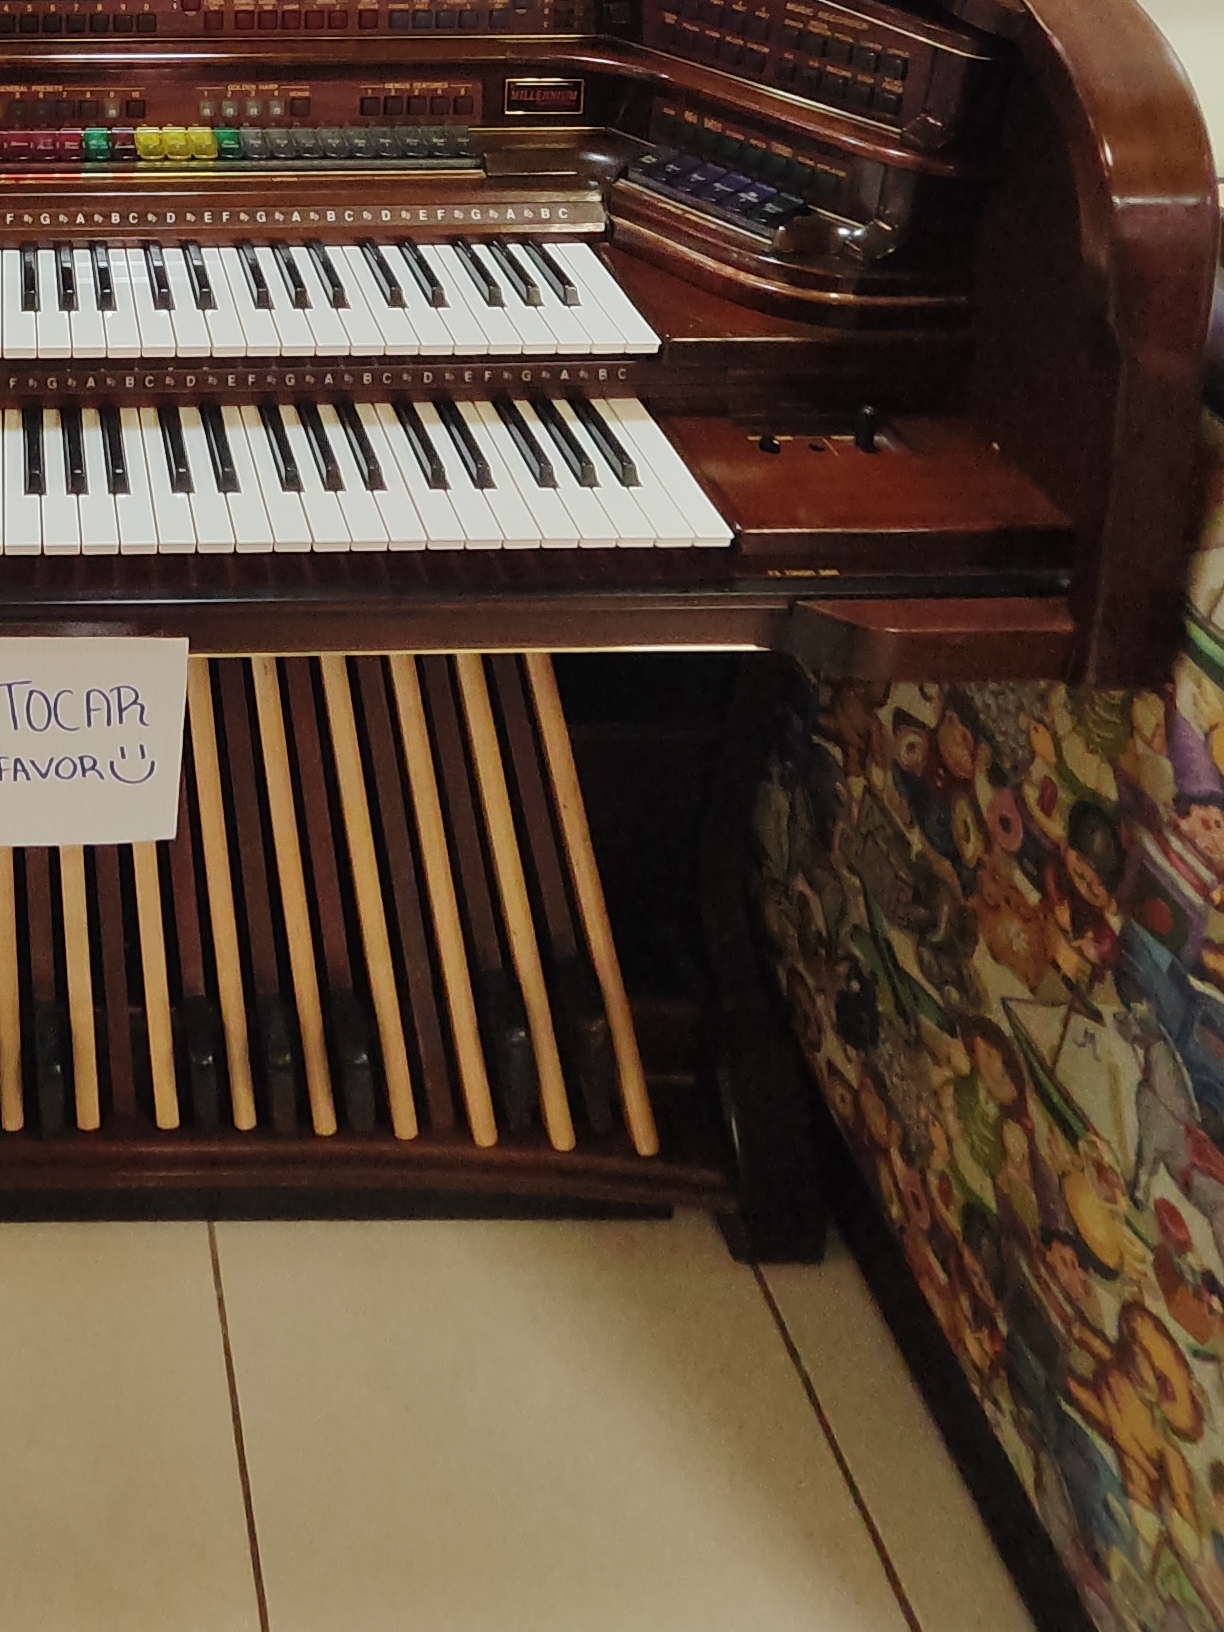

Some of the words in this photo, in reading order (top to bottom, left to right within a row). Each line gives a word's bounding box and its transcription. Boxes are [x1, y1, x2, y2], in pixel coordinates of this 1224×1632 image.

[3, 4, 9, 12] 4
[26, 4, 33, 12] 5
[50, 4, 56, 12] 6
[74, 4, 79, 12] 7
[511, 90, 578, 101] MILLENNIUM
[7, 213, 13, 224] F
[40, 213, 50, 224] G
[76, 213, 85, 223] A
[111, 213, 120, 223] B
[129, 213, 138, 223] C
[167, 213, 175, 223] D
[204, 212, 212, 222] E
[222, 212, 230, 222] F
[257, 212, 266, 222] G
[292, 211, 301, 221] A
[327, 211, 335, 221] B
[345, 211, 353, 221] C
[381, 210, 390, 220] D
[419, 210, 427, 220] E
[437, 210, 445, 220] F
[471, 209, 481, 220] G
[507, 209, 515, 219] A
[540, 208, 550, 218] B
[558, 208, 567, 218] C
[10, 378, 16, 388] F
[47, 378, 57, 389] G
[87, 377, 95, 388] A
[126, 377, 134, 388] B
[145, 376, 154, 387] C
[187, 376, 195, 386] D
[228, 375, 235, 386] E
[248, 374, 255, 386] F
[286, 374, 295, 385] G
[325, 374, 333, 384] A
[363, 373, 371, 384] B
[383, 373, 391, 384] C
[424, 372, 432, 383] D
[465, 371, 472, 382] E
[485, 371, 491, 381] F
[522, 370, 531, 381] G
[560, 370, 569, 380] A
[599, 369, 607, 380] B
[618, 368, 626, 379] C
